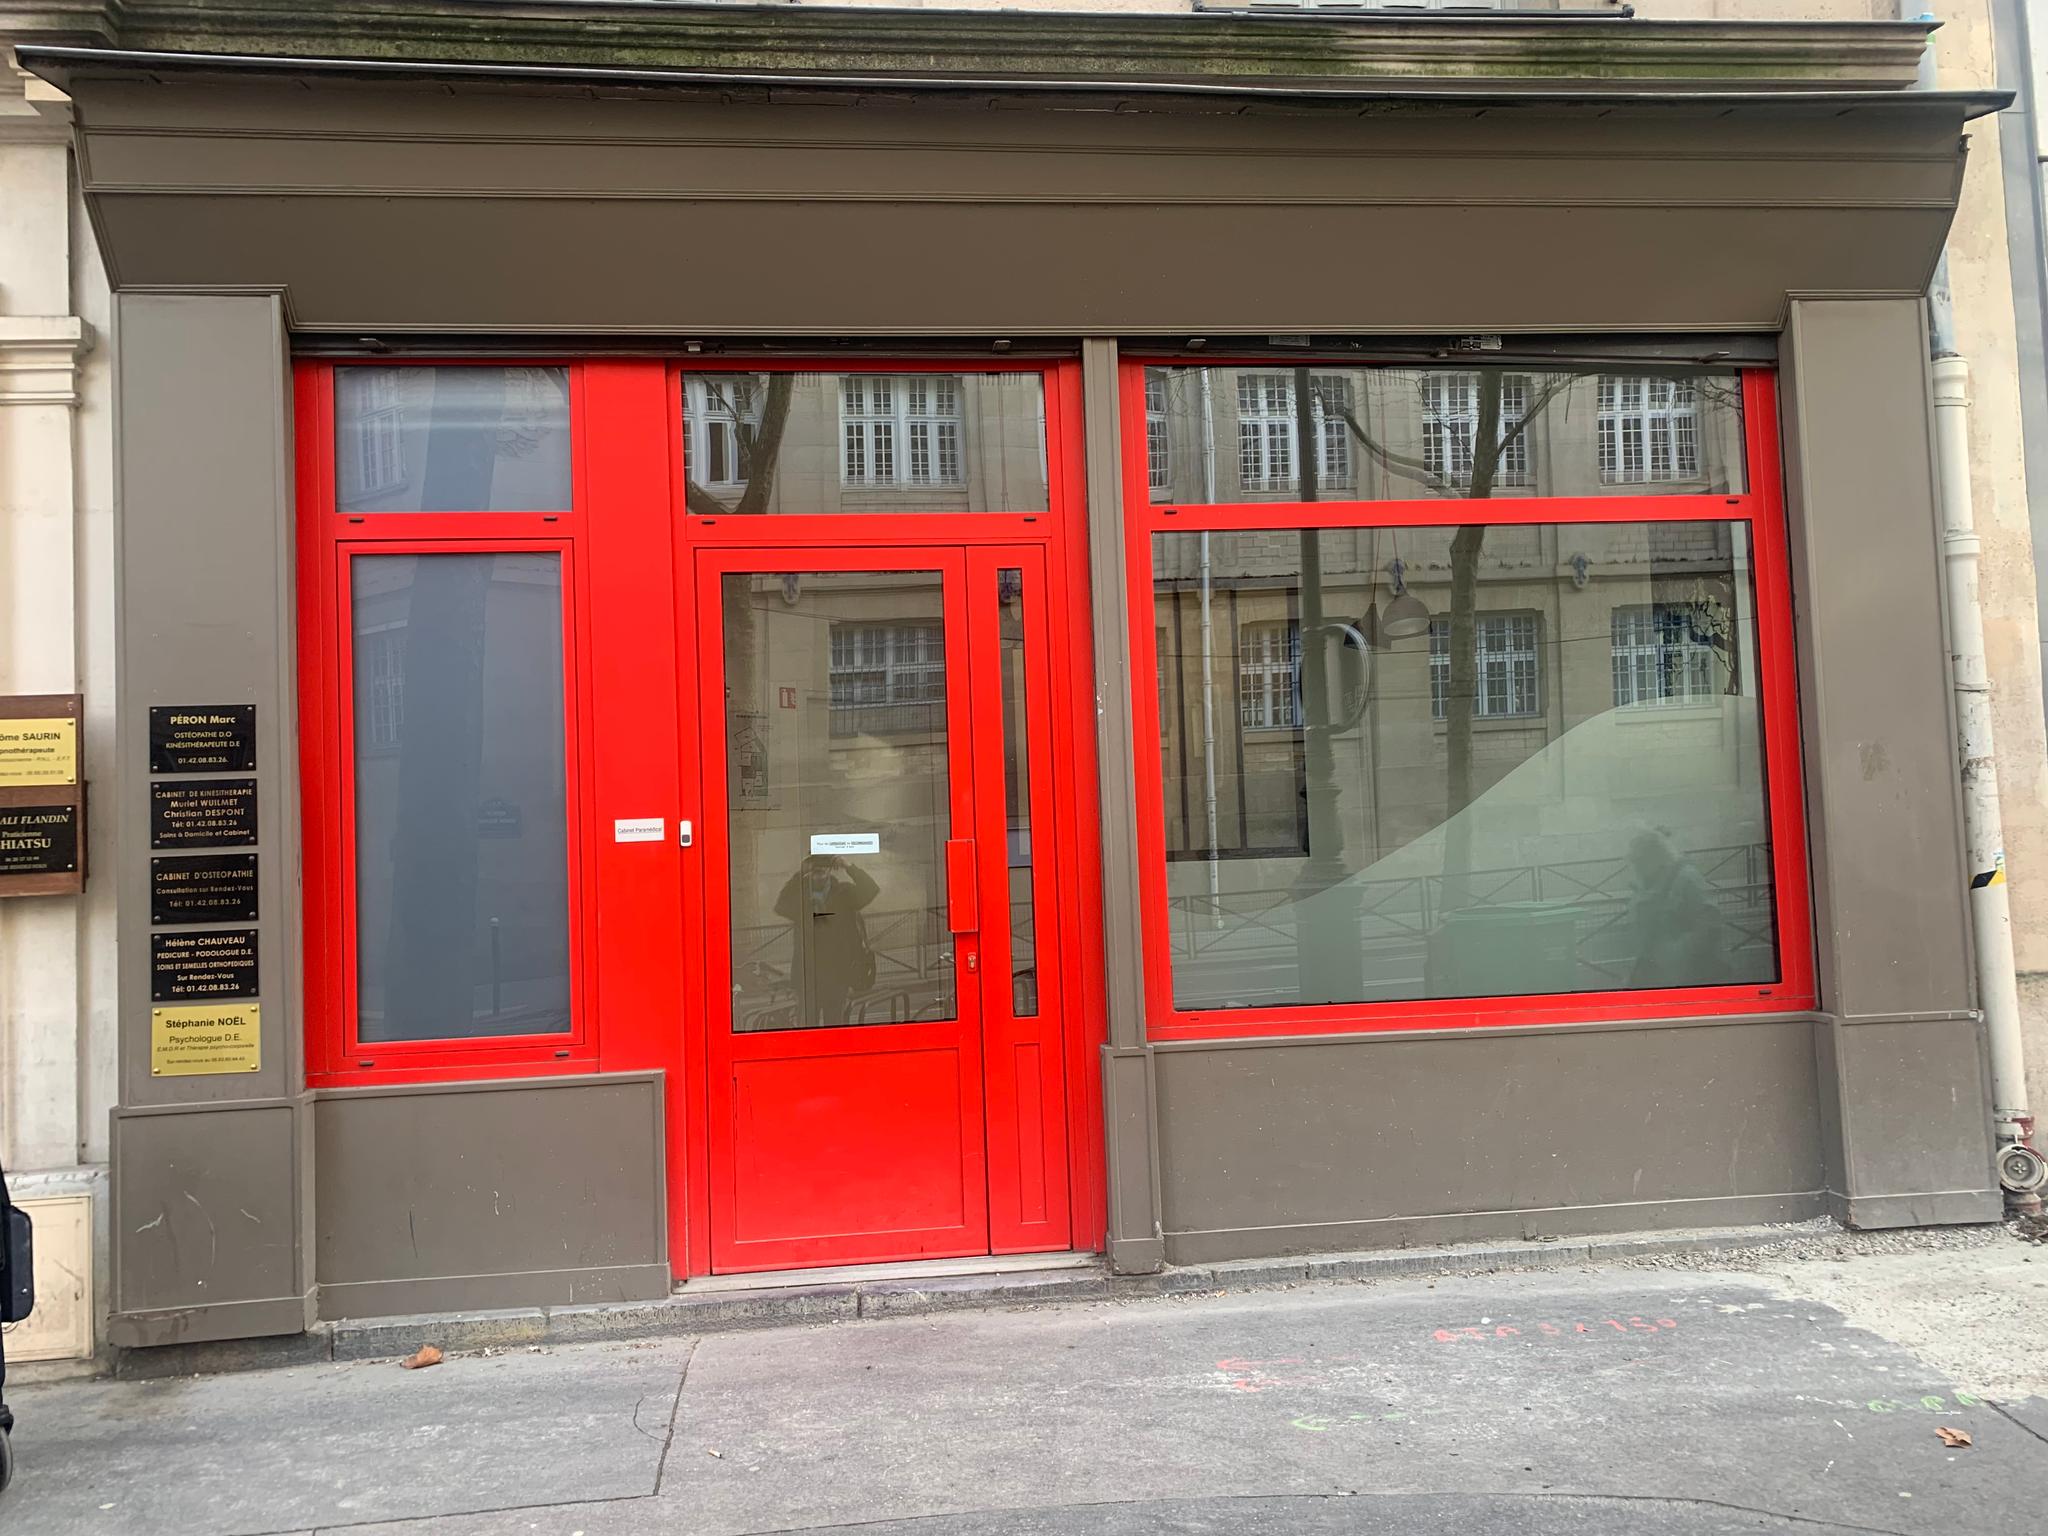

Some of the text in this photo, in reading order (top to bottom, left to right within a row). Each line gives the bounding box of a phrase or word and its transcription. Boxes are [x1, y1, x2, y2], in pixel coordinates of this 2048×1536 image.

[170, 714, 236, 724] PÉRON Marc
[22, 732, 60, 741] SAURIN
[174, 731, 217, 739] OSTÉOPATHE
[165, 741, 228, 749] KINÉSITHÉRAPEUTE
[155, 791, 186, 799] CABINET
[200, 788, 253, 796] KINESITHERAPIE
[170, 799, 238, 808] Muriel WUILMET
[163, 808, 244, 818] Christian DESPONT
[21, 815, 69, 824] FLANDIN
[186, 819, 237, 827] 01.42.08.83.26
[156, 870, 254, 881] CABINET D'OSTEOPATHIE
[185, 899, 241, 907] 01.42.08.83.26
[165, 936, 246, 947] Hélène CHAUVEAU
[195, 949, 240, 957] PODOLOGUE
[156, 963, 174, 971] SOINS
[189, 972, 235, 980] Rendez-Vous
[172, 983, 240, 993] Tél: 01.42.08.83.26
[166, 1016, 246, 1029] Stéphanie NOËL
[169, 1033, 242, 1045] Psychologue D.E.
